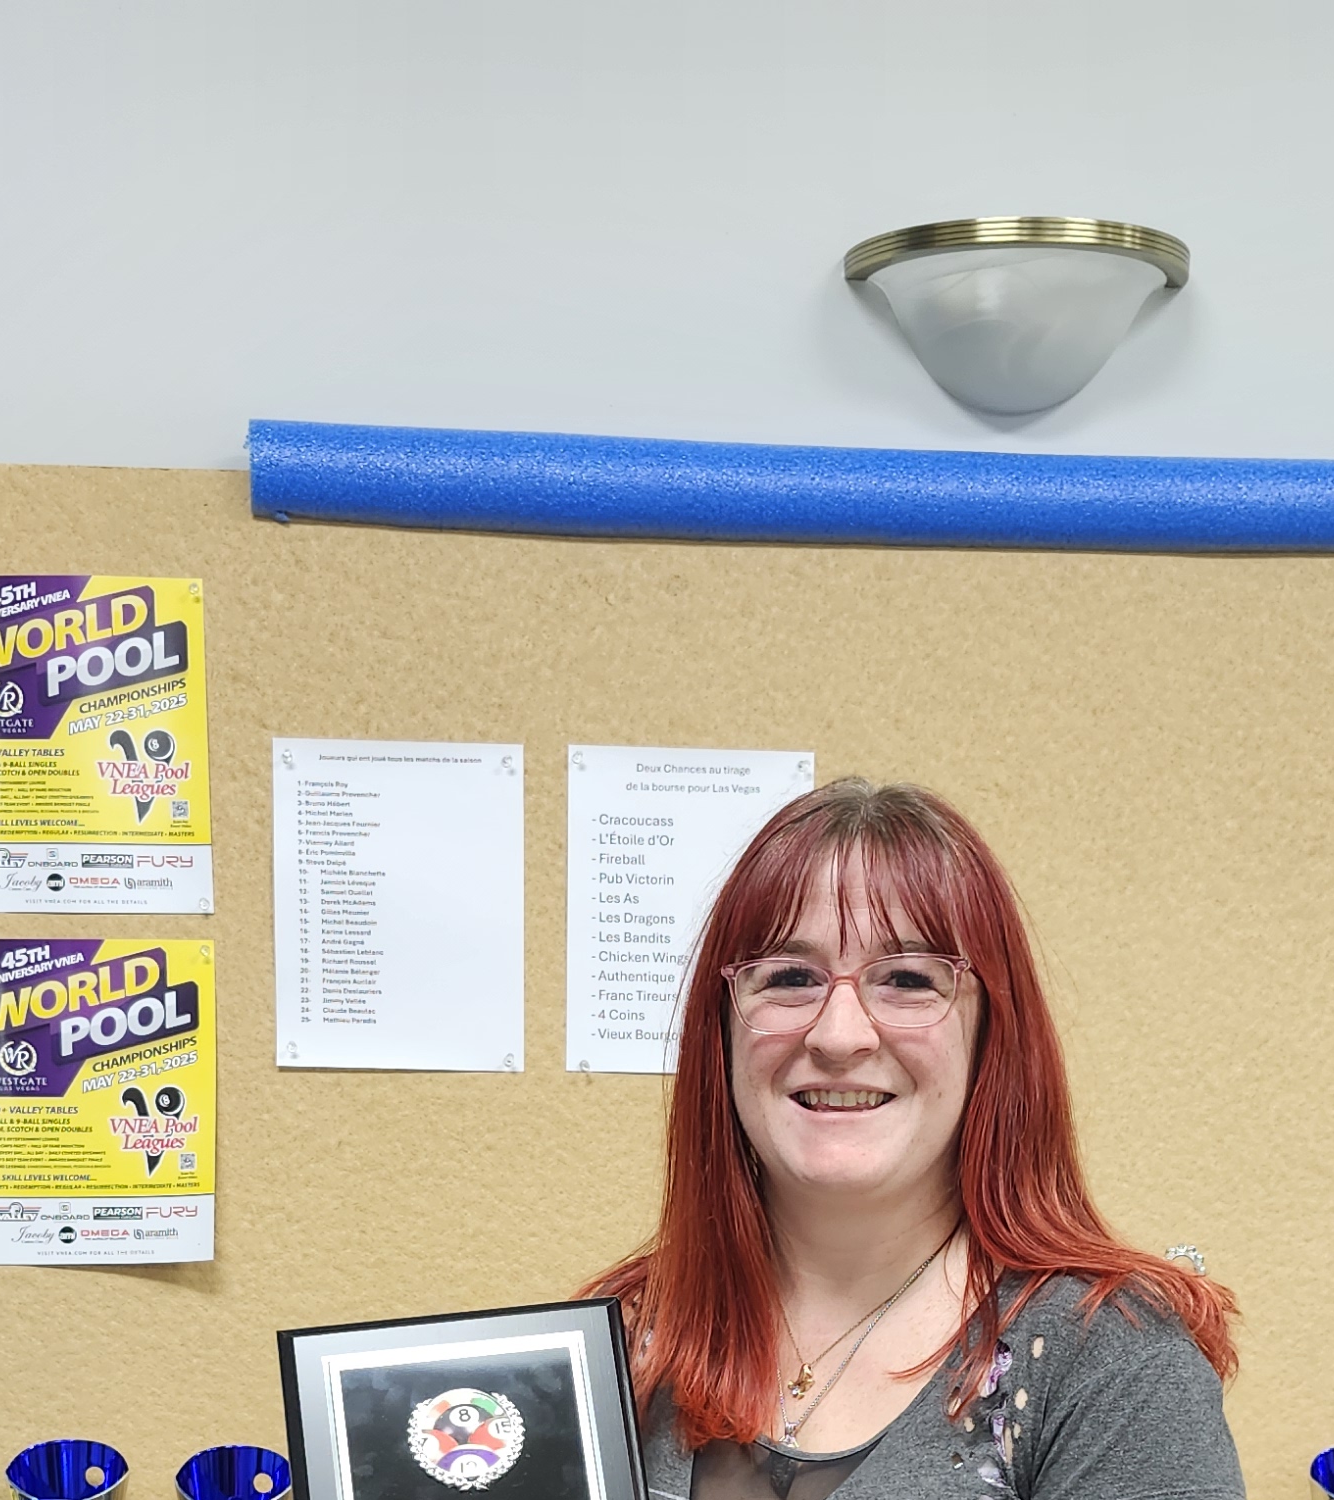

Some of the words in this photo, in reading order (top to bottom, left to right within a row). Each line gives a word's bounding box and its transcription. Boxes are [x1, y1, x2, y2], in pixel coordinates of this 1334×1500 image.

[46, 631, 179, 697] POOL
[79, 678, 186, 714] CHAMPIONSHIPS
[97, 762, 150, 779] VNEA
[154, 761, 190, 780] Pool
[636, 763, 661, 774] Deux
[663, 764, 707, 775] Chances
[709, 766, 722, 775] au
[723, 765, 751, 777] tirage
[111, 779, 176, 799] Leagues
[626, 782, 638, 791] de
[640, 782, 649, 791] la
[652, 783, 685, 792] bourse
[687, 784, 710, 794] pour
[712, 784, 729, 793] Las
[731, 784, 760, 796] Vegas
[599, 813, 674, 827] Cracoucass
[599, 830, 645, 846] L'Étoile
[647, 834, 675, 846] d'Or
[599, 853, 646, 865] Fireball
[599, 872, 623, 884] Pub
[625, 873, 674, 886] Victorin
[599, 892, 621, 904] Les
[623, 893, 640, 904] As
[599, 912, 621, 924] Les
[624, 912, 675, 926] Dragons
[599, 931, 621, 943] Les
[623, 932, 671, 944] Bandits
[598, 951, 650, 963] Chicken
[652, 952, 689, 966] Wings
[598, 970, 675, 984] Authentique
[598, 989, 634, 1002] Franc
[636, 990, 677, 1002] Tireurs
[598, 1009, 606, 1019] 4
[609, 1009, 645, 1021] Coins
[61, 991, 191, 1056] POOL
[598, 1028, 632, 1040] Vieux
[92, 1036, 196, 1072] CHAMPIONSHIPS
[110, 1118, 159, 1133] VNEA
[164, 1117, 198, 1132] Pool
[122, 1135, 185, 1155] Leagues
[458, 1409, 471, 1422] 8
[495, 1419, 511, 1434] 15
